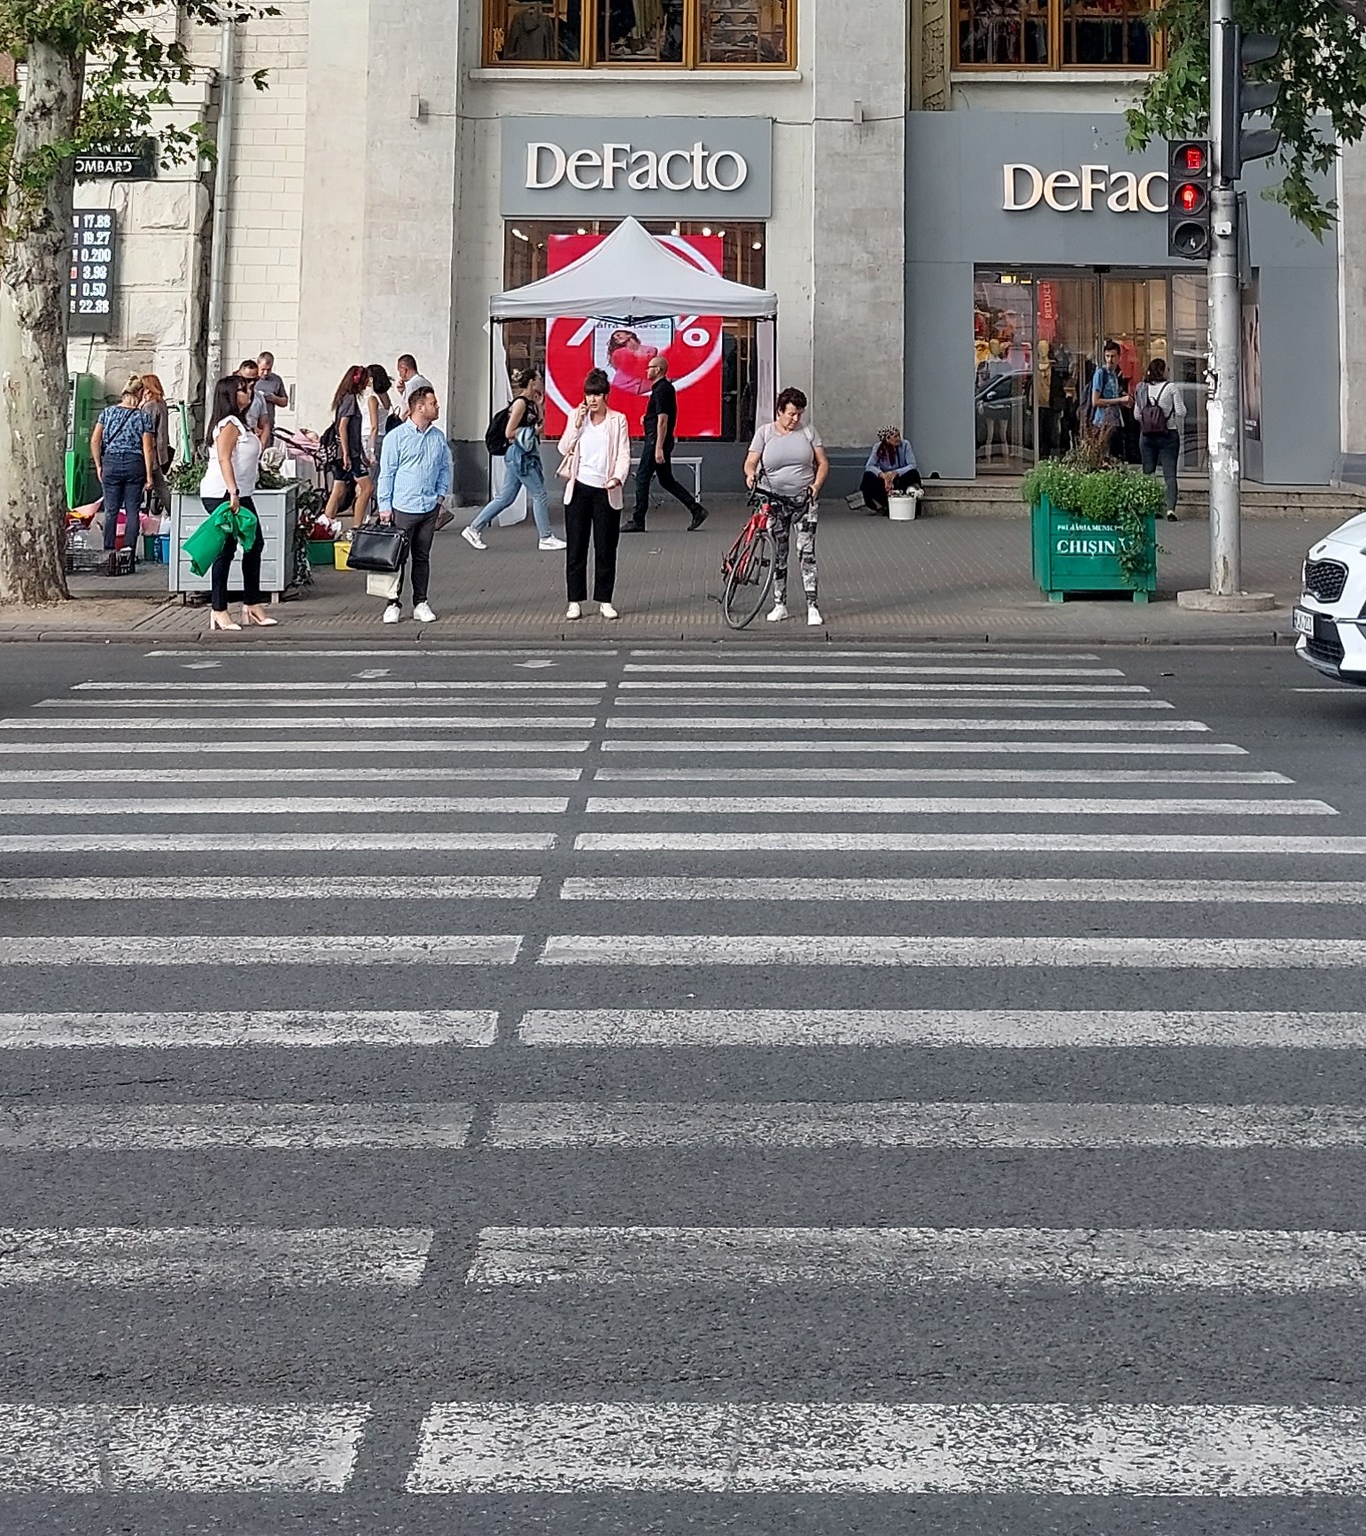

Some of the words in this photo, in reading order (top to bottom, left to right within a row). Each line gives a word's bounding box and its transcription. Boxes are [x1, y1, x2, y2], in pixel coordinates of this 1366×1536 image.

[75, 159, 133, 173] OMBARD
[525, 141, 748, 191] DeFacto
[1002, 163, 1169, 213] DeFac
